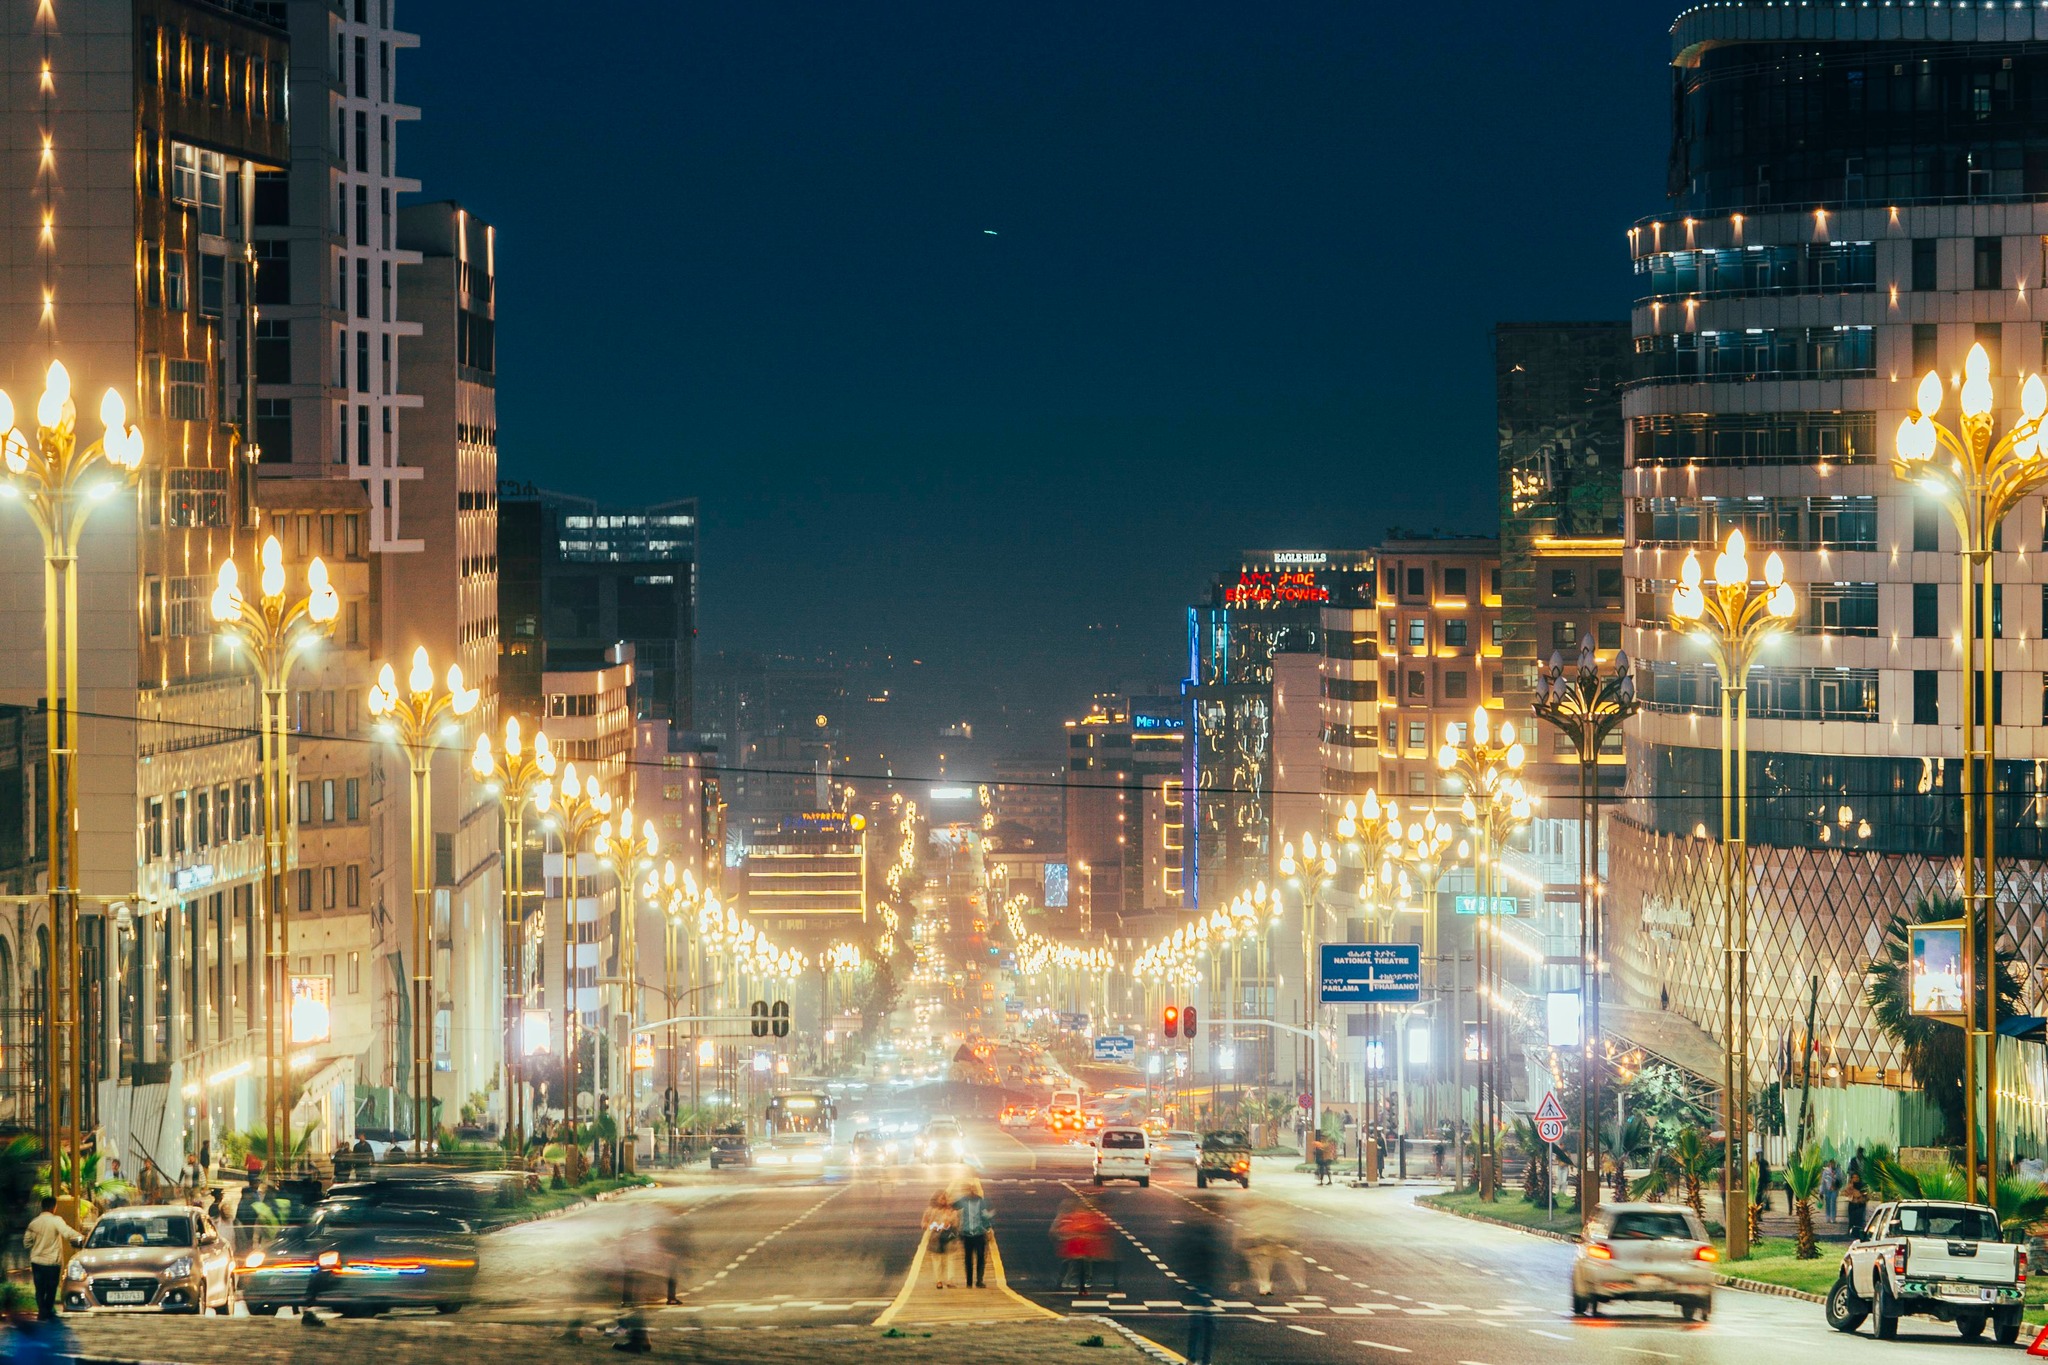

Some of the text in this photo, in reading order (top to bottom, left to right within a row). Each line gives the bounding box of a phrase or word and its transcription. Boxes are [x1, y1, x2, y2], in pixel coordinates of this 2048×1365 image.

[1274, 553, 1327, 563] EAGLE HILLS
[1276, 588, 1329, 602] TOWER
[1333, 957, 1409, 965] NATIONAL THEATRE
[1543, 1123, 1559, 1136] 30
